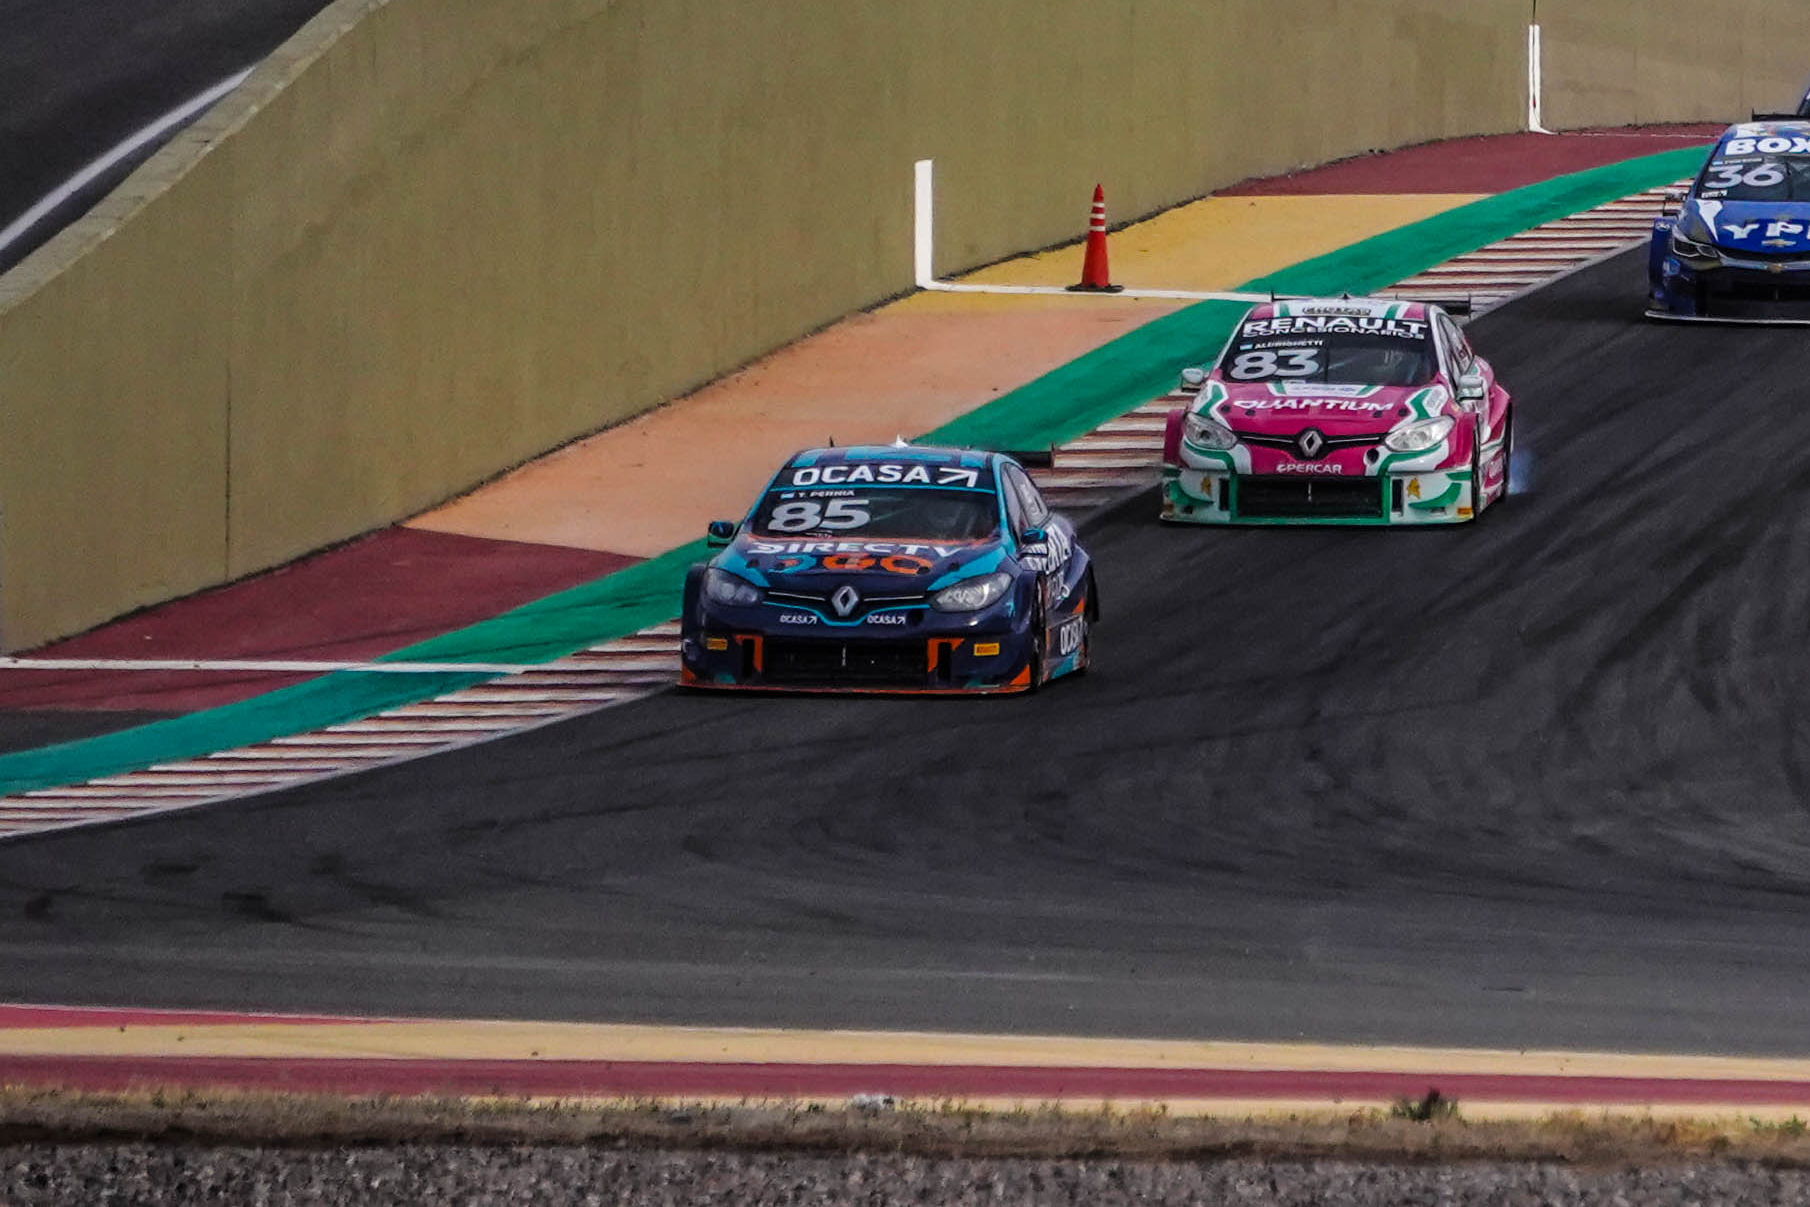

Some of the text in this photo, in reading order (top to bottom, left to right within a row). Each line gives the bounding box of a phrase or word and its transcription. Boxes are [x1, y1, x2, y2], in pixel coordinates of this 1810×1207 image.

[1703, 163, 1785, 188] 36
[1243, 317, 1428, 334] RENAULT
[1230, 349, 1319, 380] 83
[1233, 399, 1396, 411] QUANTIUM
[792, 465, 930, 486] OCASA
[767, 499, 871, 532] 85
[779, 614, 808, 624] OCASA
[867, 614, 897, 624] OCASA
